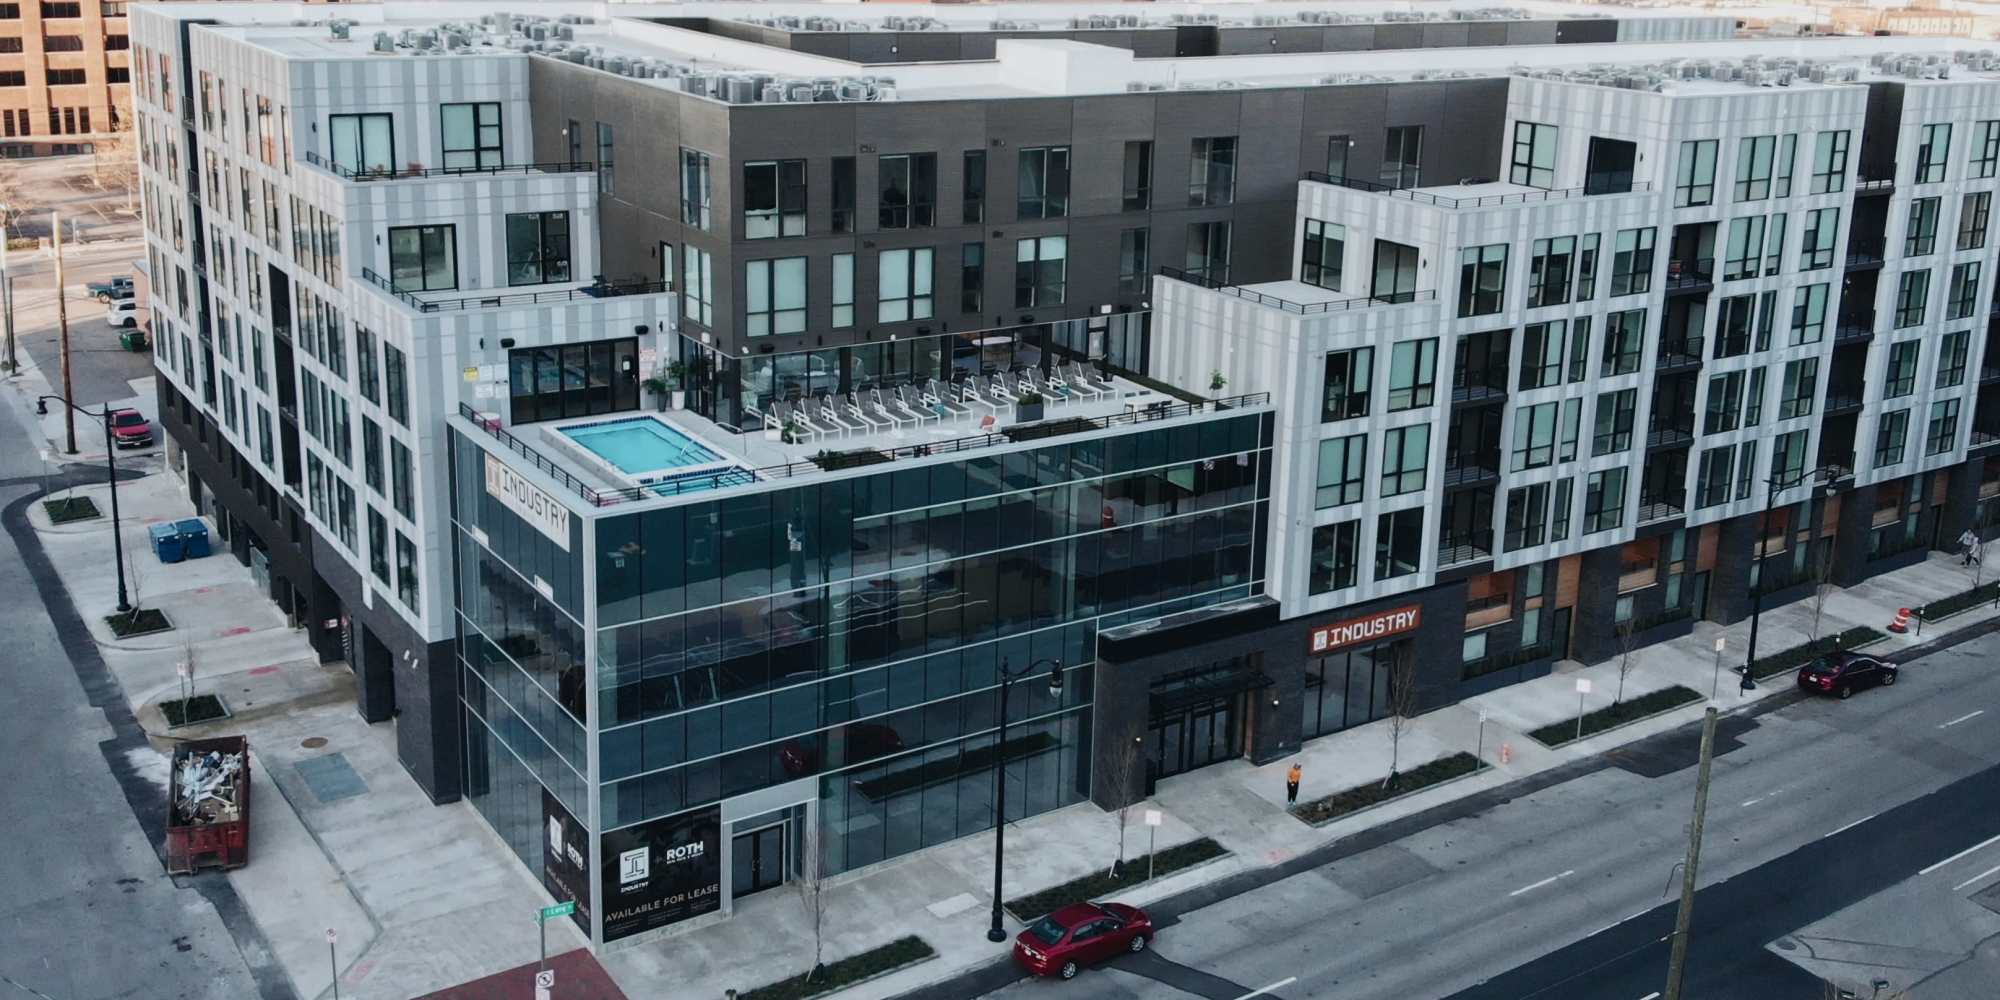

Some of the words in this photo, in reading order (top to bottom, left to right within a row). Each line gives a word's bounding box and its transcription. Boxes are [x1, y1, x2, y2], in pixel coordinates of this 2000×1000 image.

[502, 468, 567, 533] INDUSTRY
[1330, 609, 1416, 646] INDUSTRY
[666, 841, 704, 861] ROTH
[605, 900, 661, 921] AVAILABLE
[663, 894, 685, 906] FOR
[687, 884, 719, 899] LEASE
